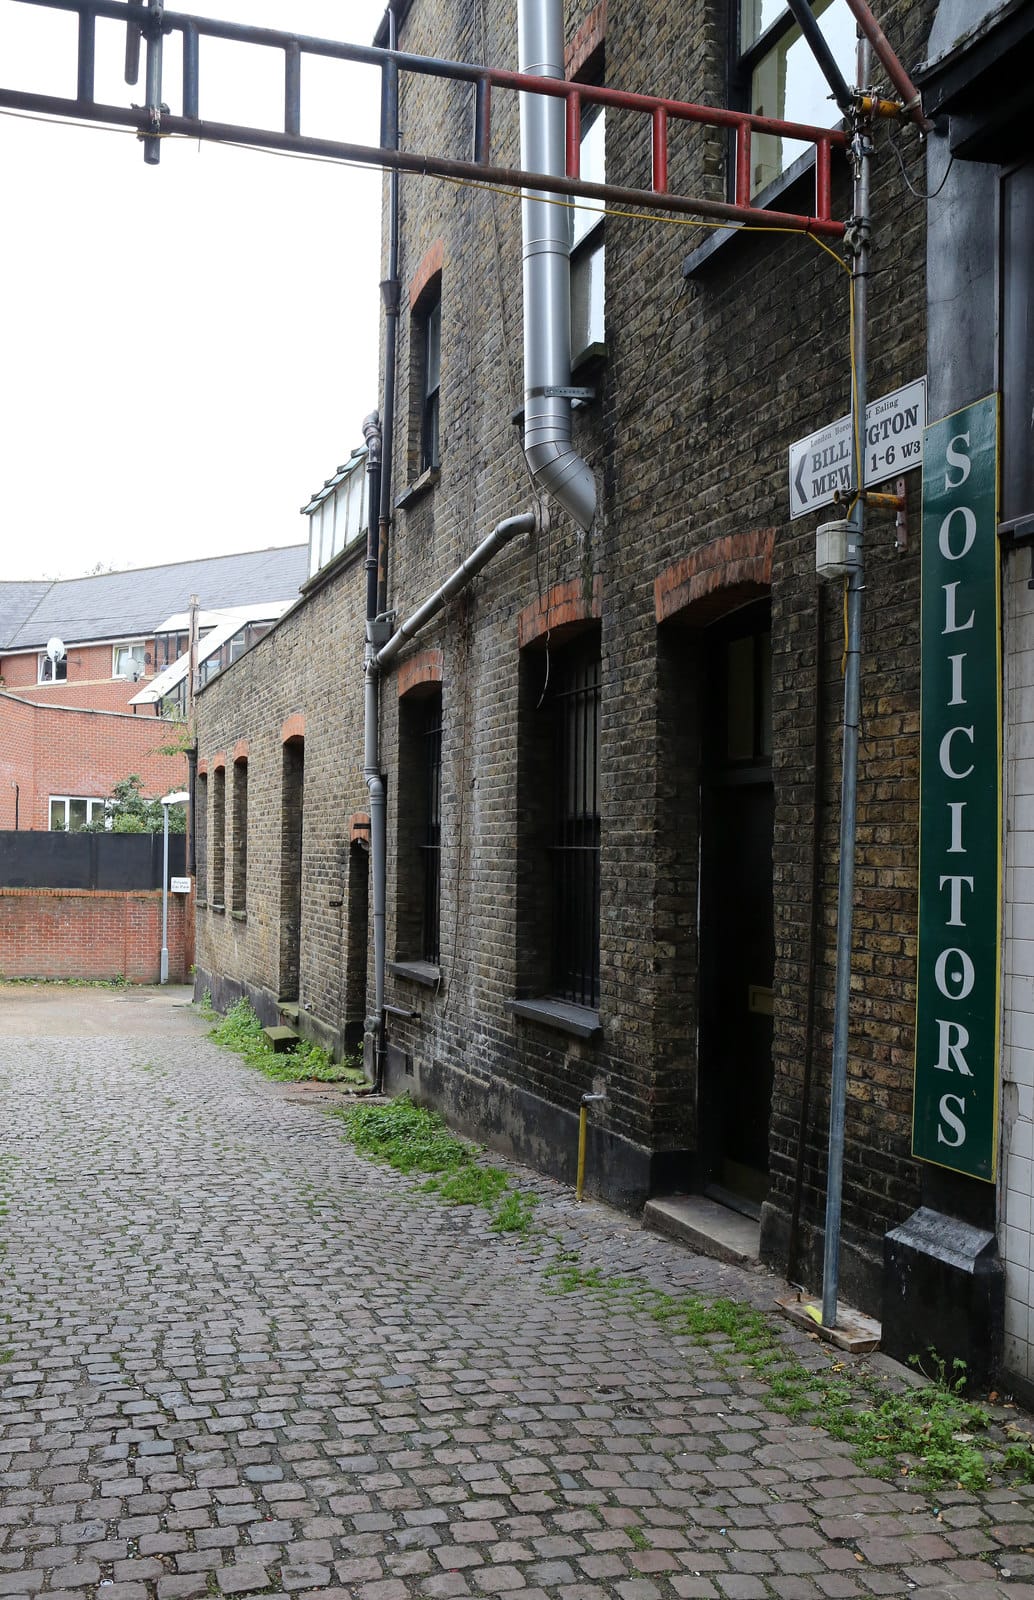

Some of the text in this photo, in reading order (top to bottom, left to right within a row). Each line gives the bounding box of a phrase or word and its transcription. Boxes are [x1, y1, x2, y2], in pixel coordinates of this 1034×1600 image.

[812, 404, 919, 474] BILLGTON
[834, 422, 852, 436] Boro
[875, 398, 899, 415] Ealing
[812, 440, 921, 499] MEW 1-6 W3
[934, 430, 977, 1147] SOLICITORS
